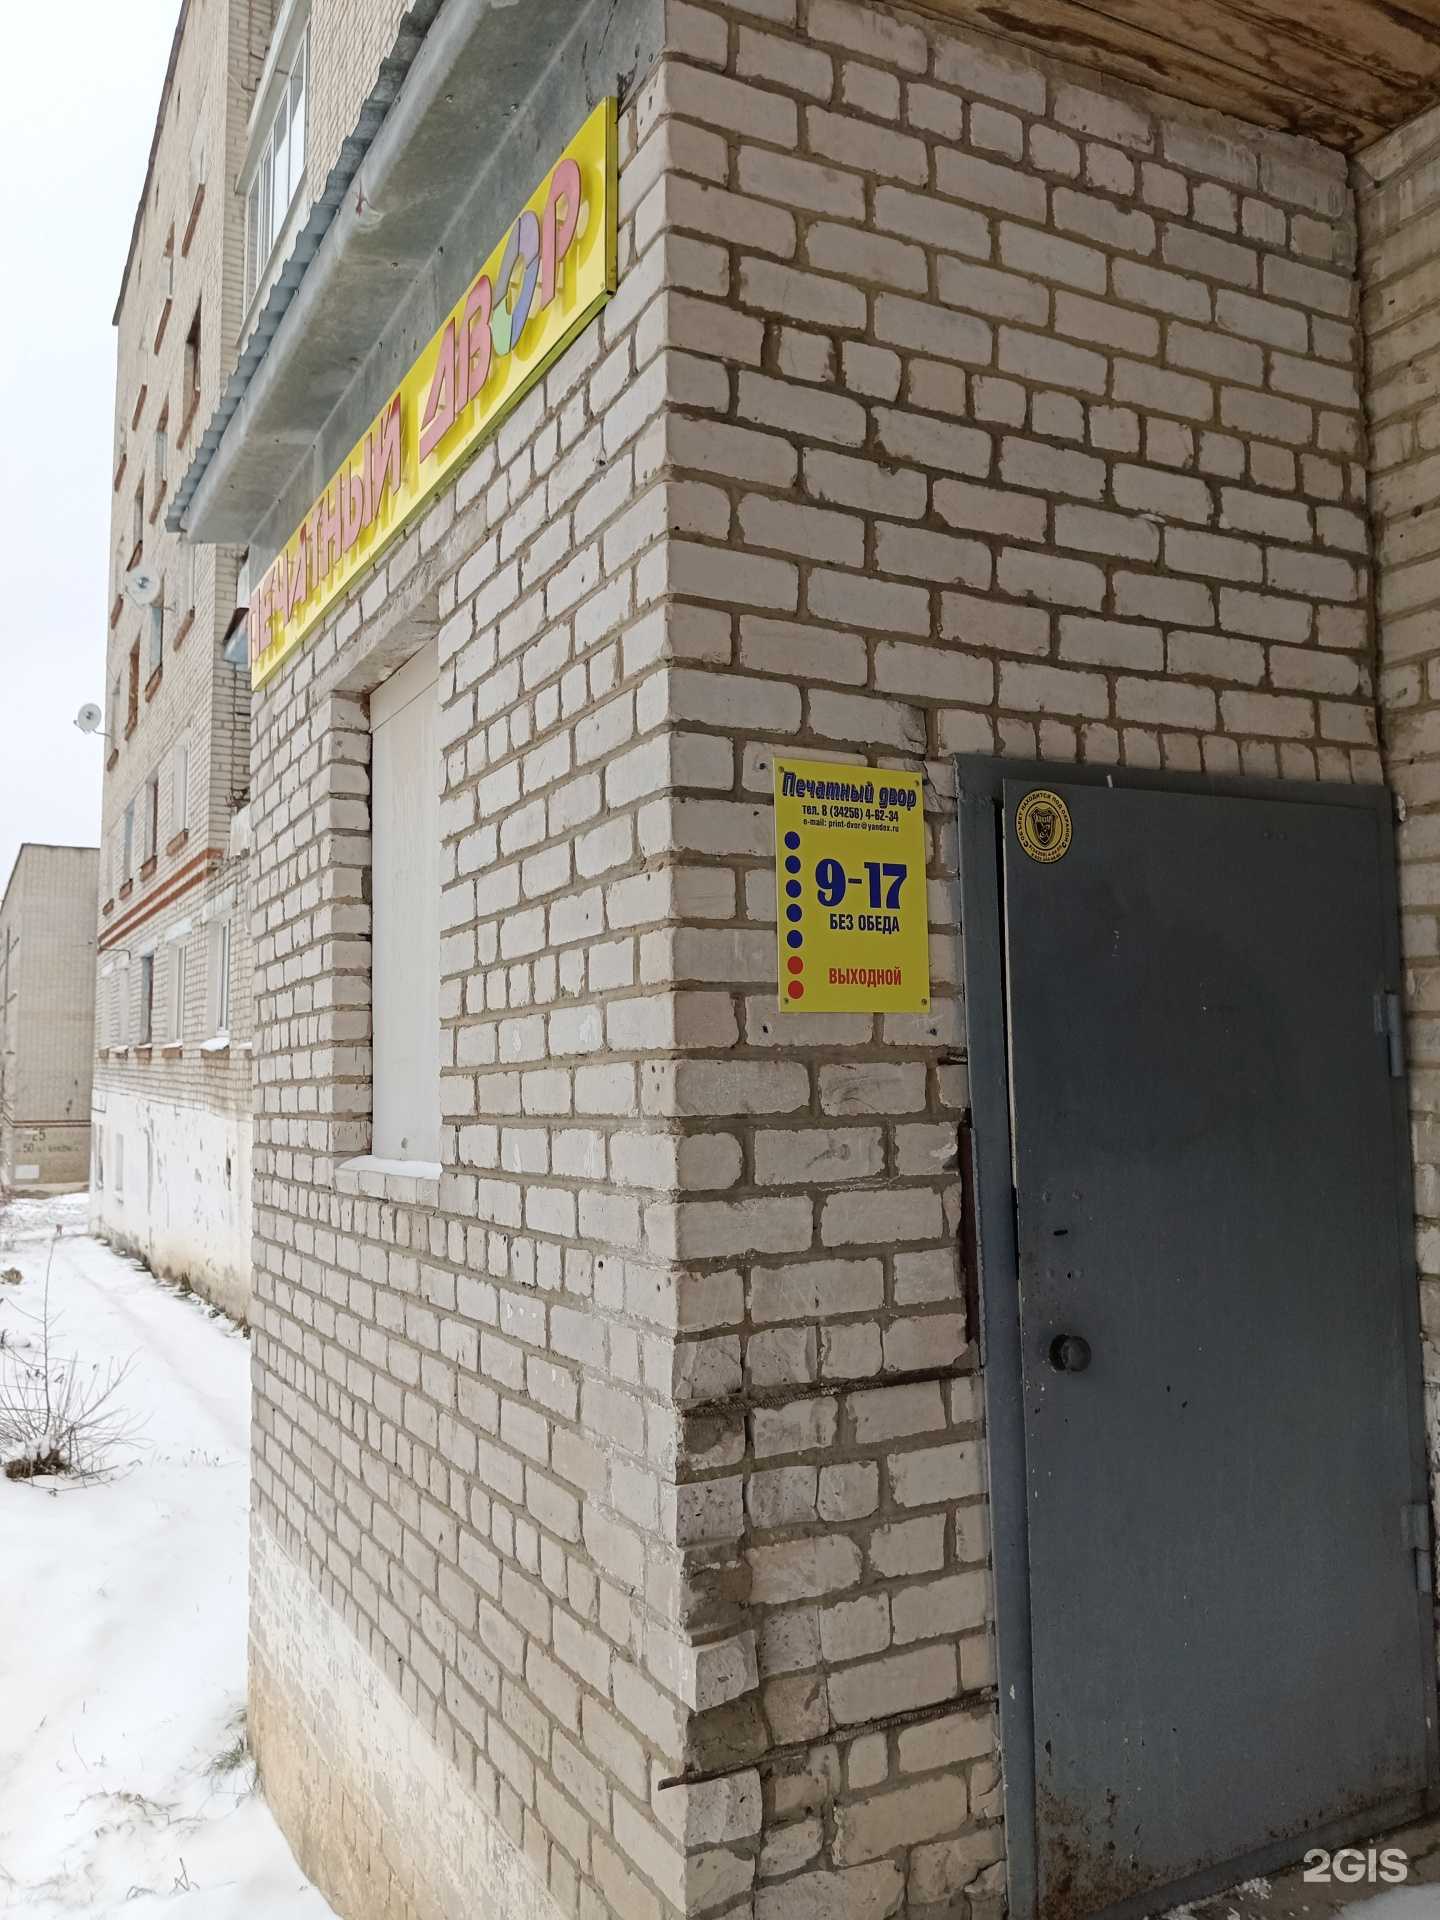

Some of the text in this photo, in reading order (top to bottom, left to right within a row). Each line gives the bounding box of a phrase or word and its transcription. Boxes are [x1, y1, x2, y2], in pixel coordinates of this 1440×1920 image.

[419, 158, 582, 464] ДВОР
[782, 771, 917, 811] Печатный двор
[815, 858, 908, 910] 9-17
[829, 913, 901, 935] БЕЗ ОБЕДА
[828, 966, 902, 988] ВЫХОДНОЙ
